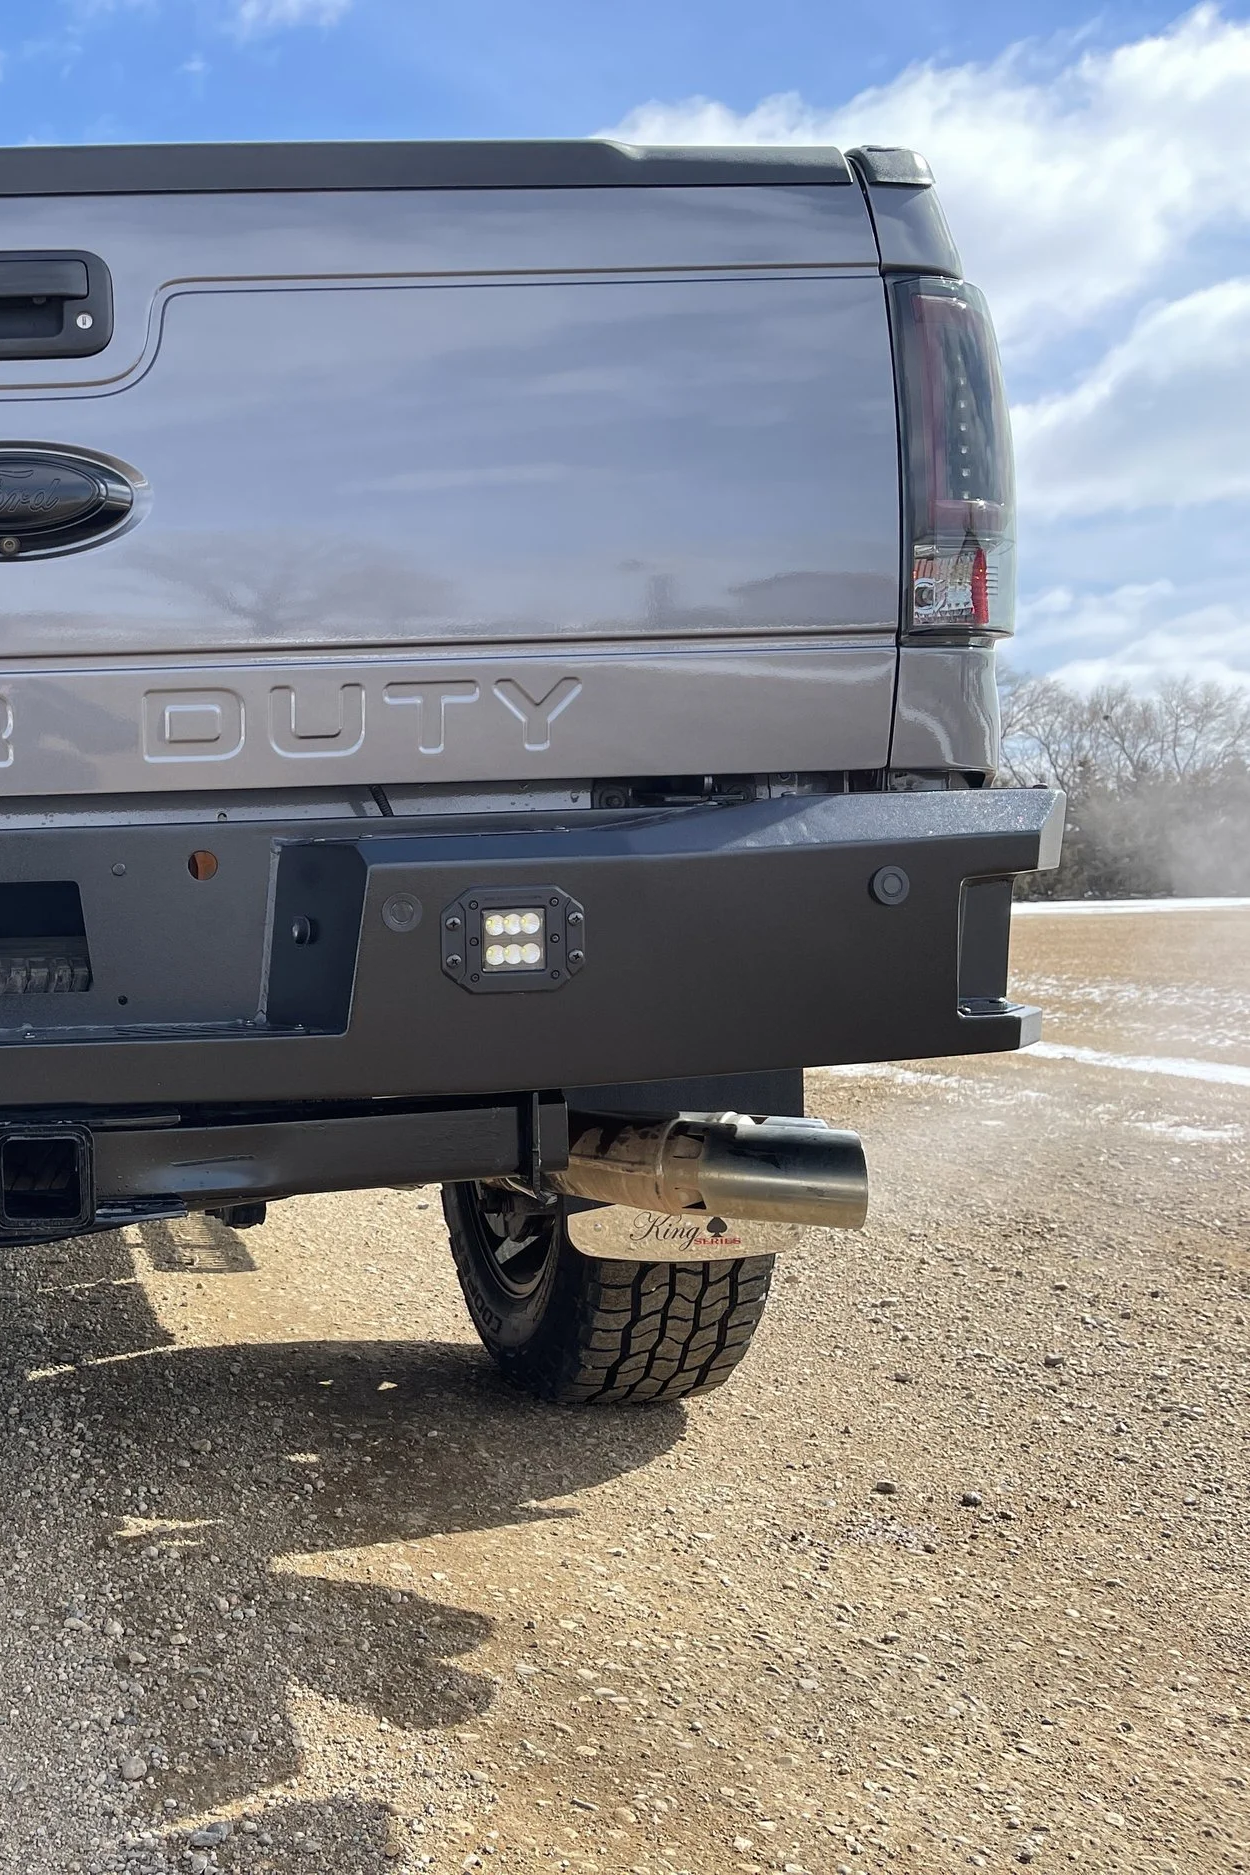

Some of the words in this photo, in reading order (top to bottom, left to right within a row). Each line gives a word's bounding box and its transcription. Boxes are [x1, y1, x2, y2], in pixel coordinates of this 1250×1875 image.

[142, 676, 583, 763] DUTY
[629, 1211, 701, 1252] King
[693, 1237, 742, 1246] SERIES
